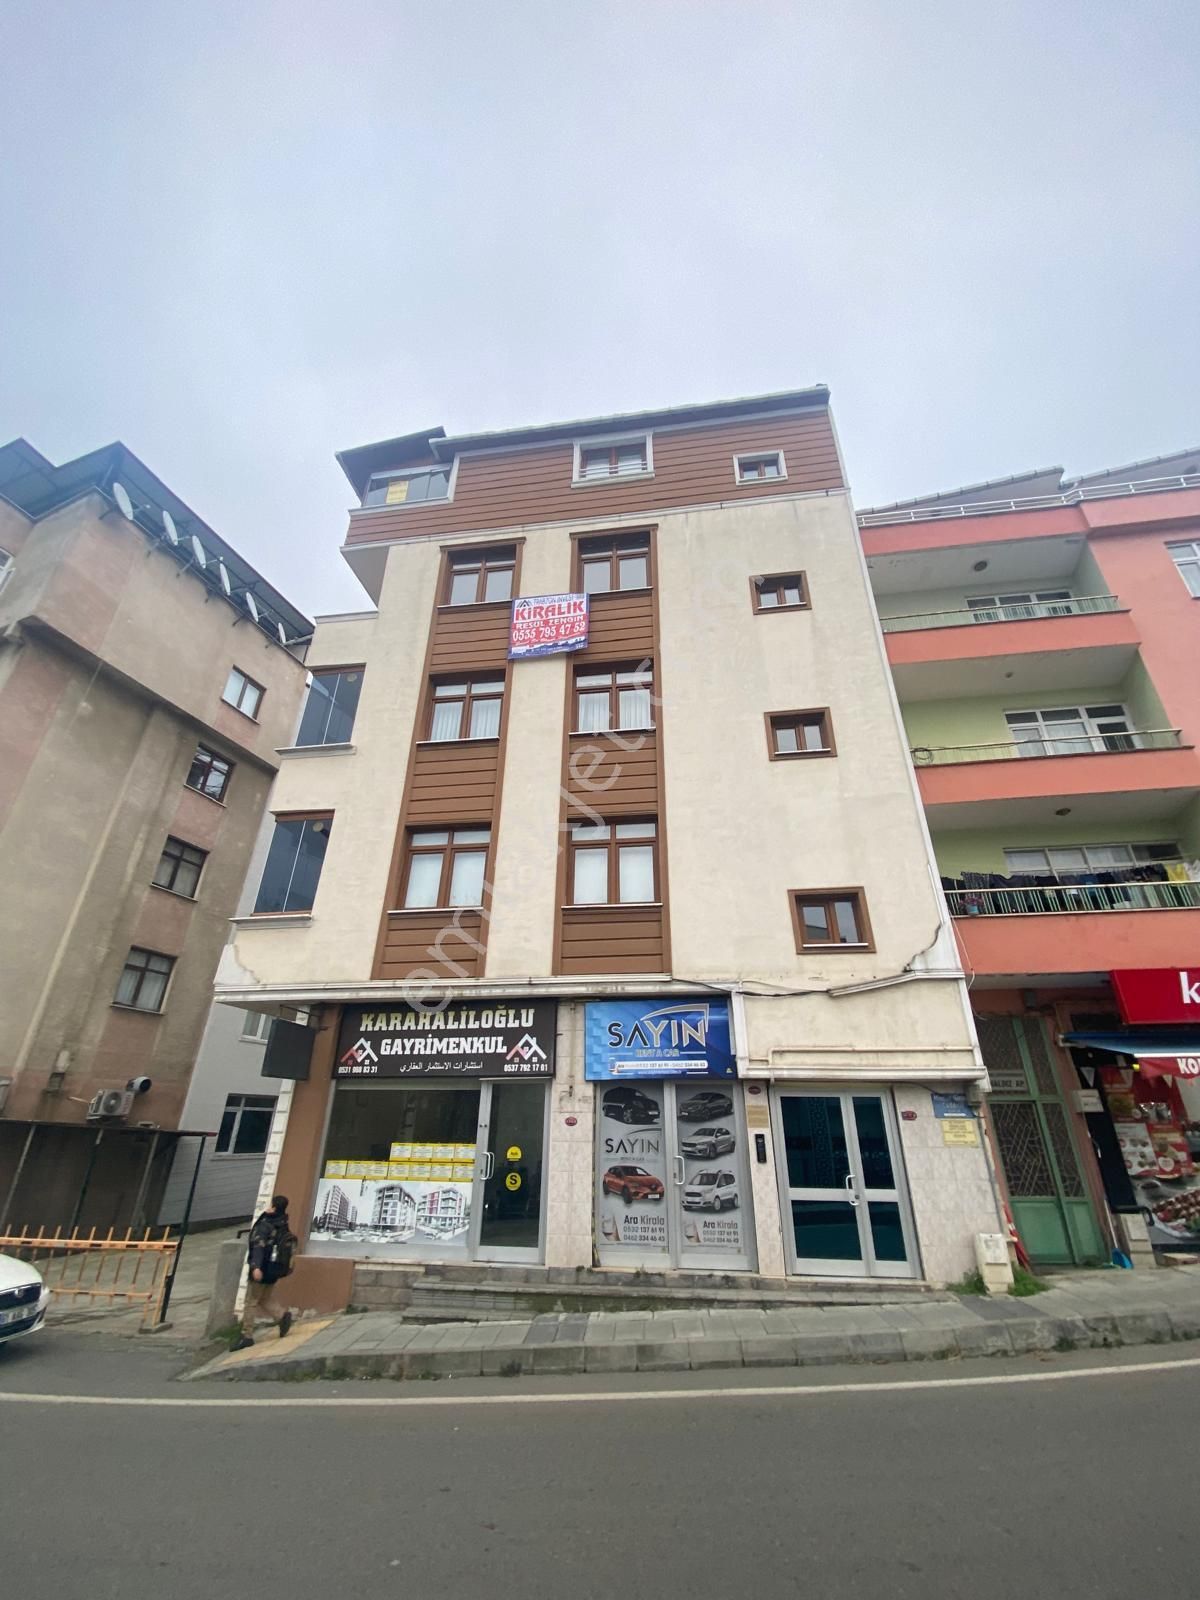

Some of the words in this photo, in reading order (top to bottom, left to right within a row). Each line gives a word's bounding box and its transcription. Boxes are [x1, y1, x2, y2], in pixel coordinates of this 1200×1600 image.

[539, 626, 557, 638] 795
[559, 624, 572, 635] 47
[573, 621, 586, 633] 52
[359, 1004, 535, 1031] KARAHALİLOĞLU
[607, 1019, 706, 1048] SAYIN
[380, 1034, 508, 1056] GAYRİMENKUL
[504, 1064, 518, 1072] 0537
[519, 1064, 531, 1072] 792
[532, 1063, 540, 1071] 17
[605, 1138, 660, 1154] SAYIN
[624, 1215, 638, 1225] Ara
[640, 1215, 665, 1225] Kirala
